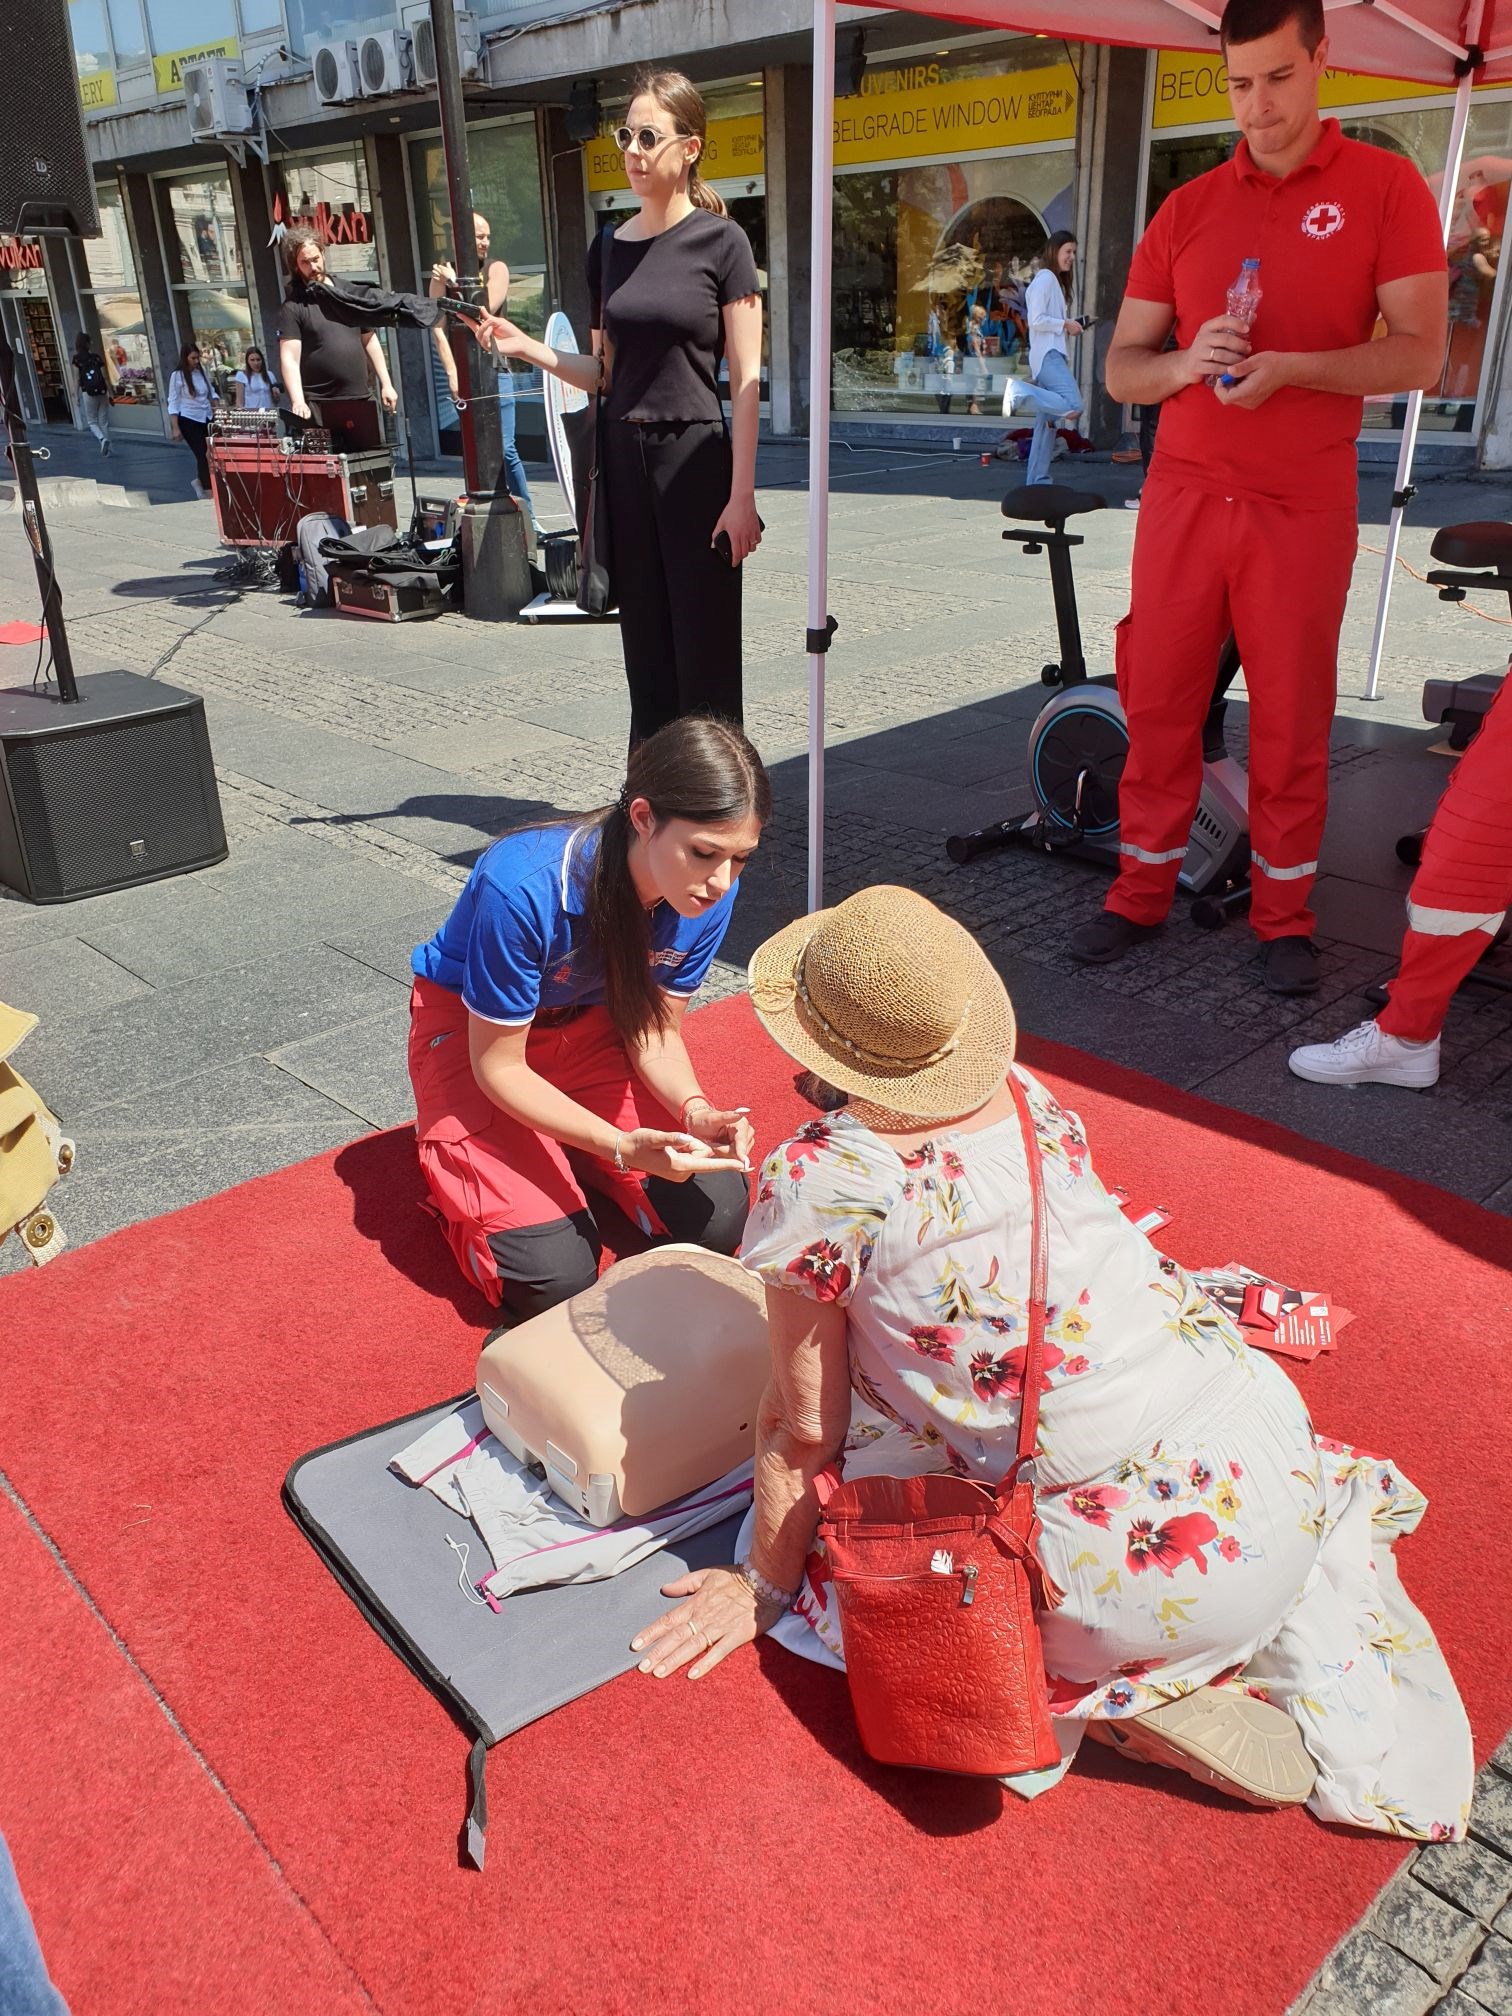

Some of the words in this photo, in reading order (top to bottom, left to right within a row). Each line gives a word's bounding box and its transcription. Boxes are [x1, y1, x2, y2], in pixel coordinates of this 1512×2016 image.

[856, 64, 940, 97] UVENIRS
[1161, 64, 1230, 101] BEOG
[832, 108, 928, 144] BELGRADE
[932, 95, 1023, 130] WINDOW
